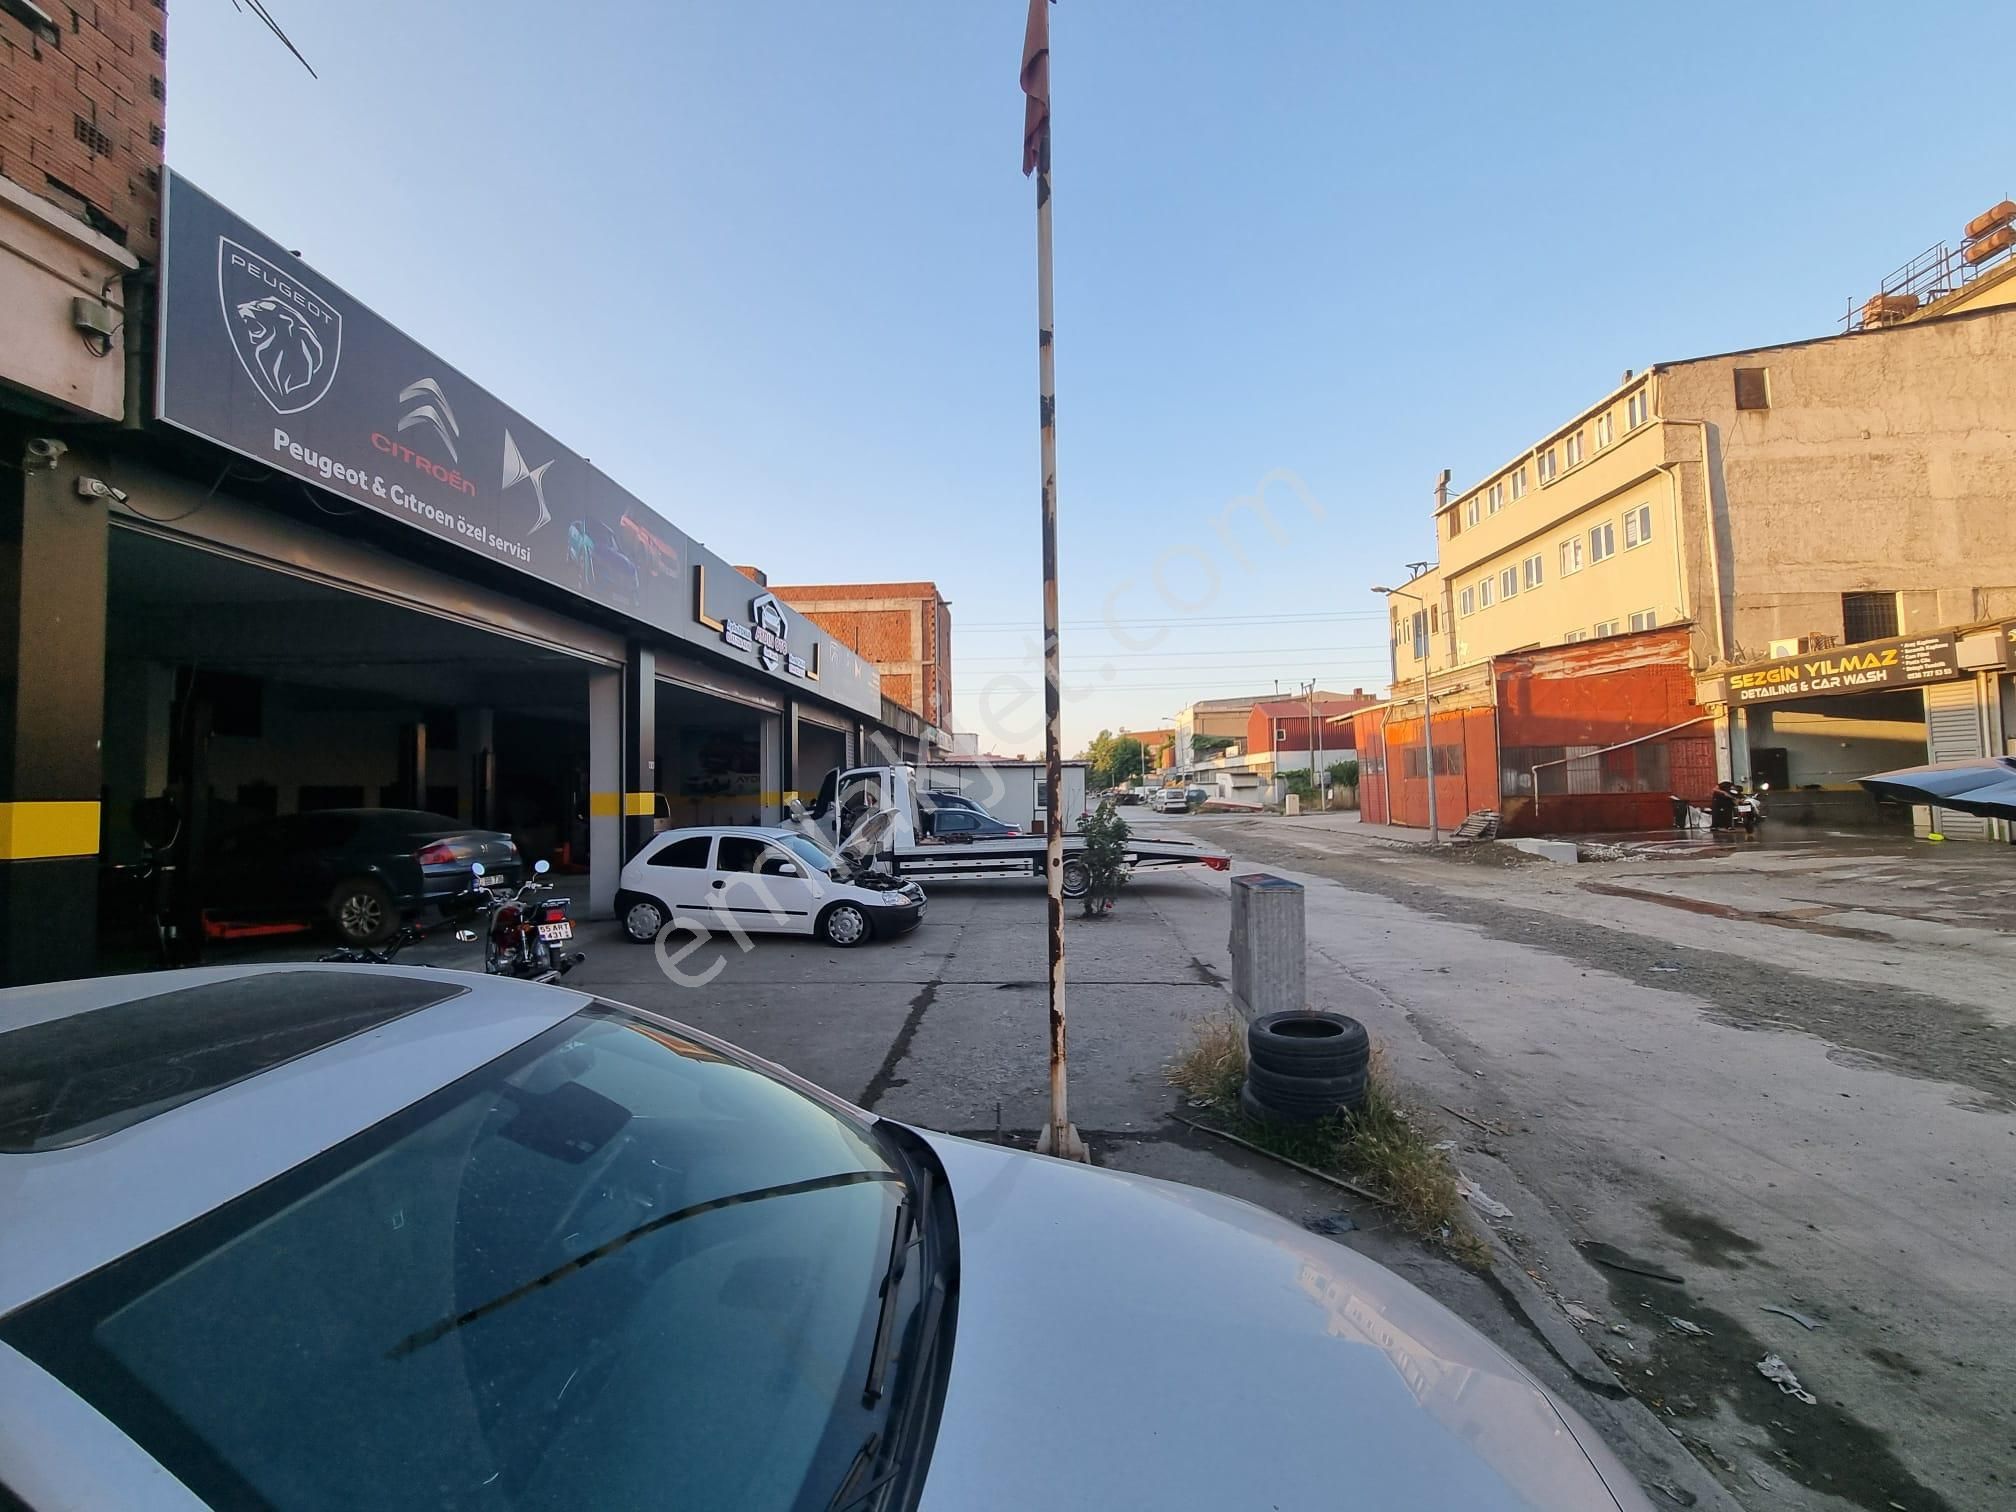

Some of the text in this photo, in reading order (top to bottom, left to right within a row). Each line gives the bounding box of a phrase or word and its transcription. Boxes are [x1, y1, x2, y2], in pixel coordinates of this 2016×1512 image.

[232, 254, 332, 324] PEUGEOT
[274, 428, 368, 490] Peugeot
[372, 476, 387, 498] &
[457, 515, 486, 542] özel
[488, 533, 531, 562] servisi
[371, 432, 477, 496] CITROËN
[1730, 649, 1898, 689] SEZGİN YILMAZ
[1741, 670, 1888, 700] DETAILING & CAR WASH
